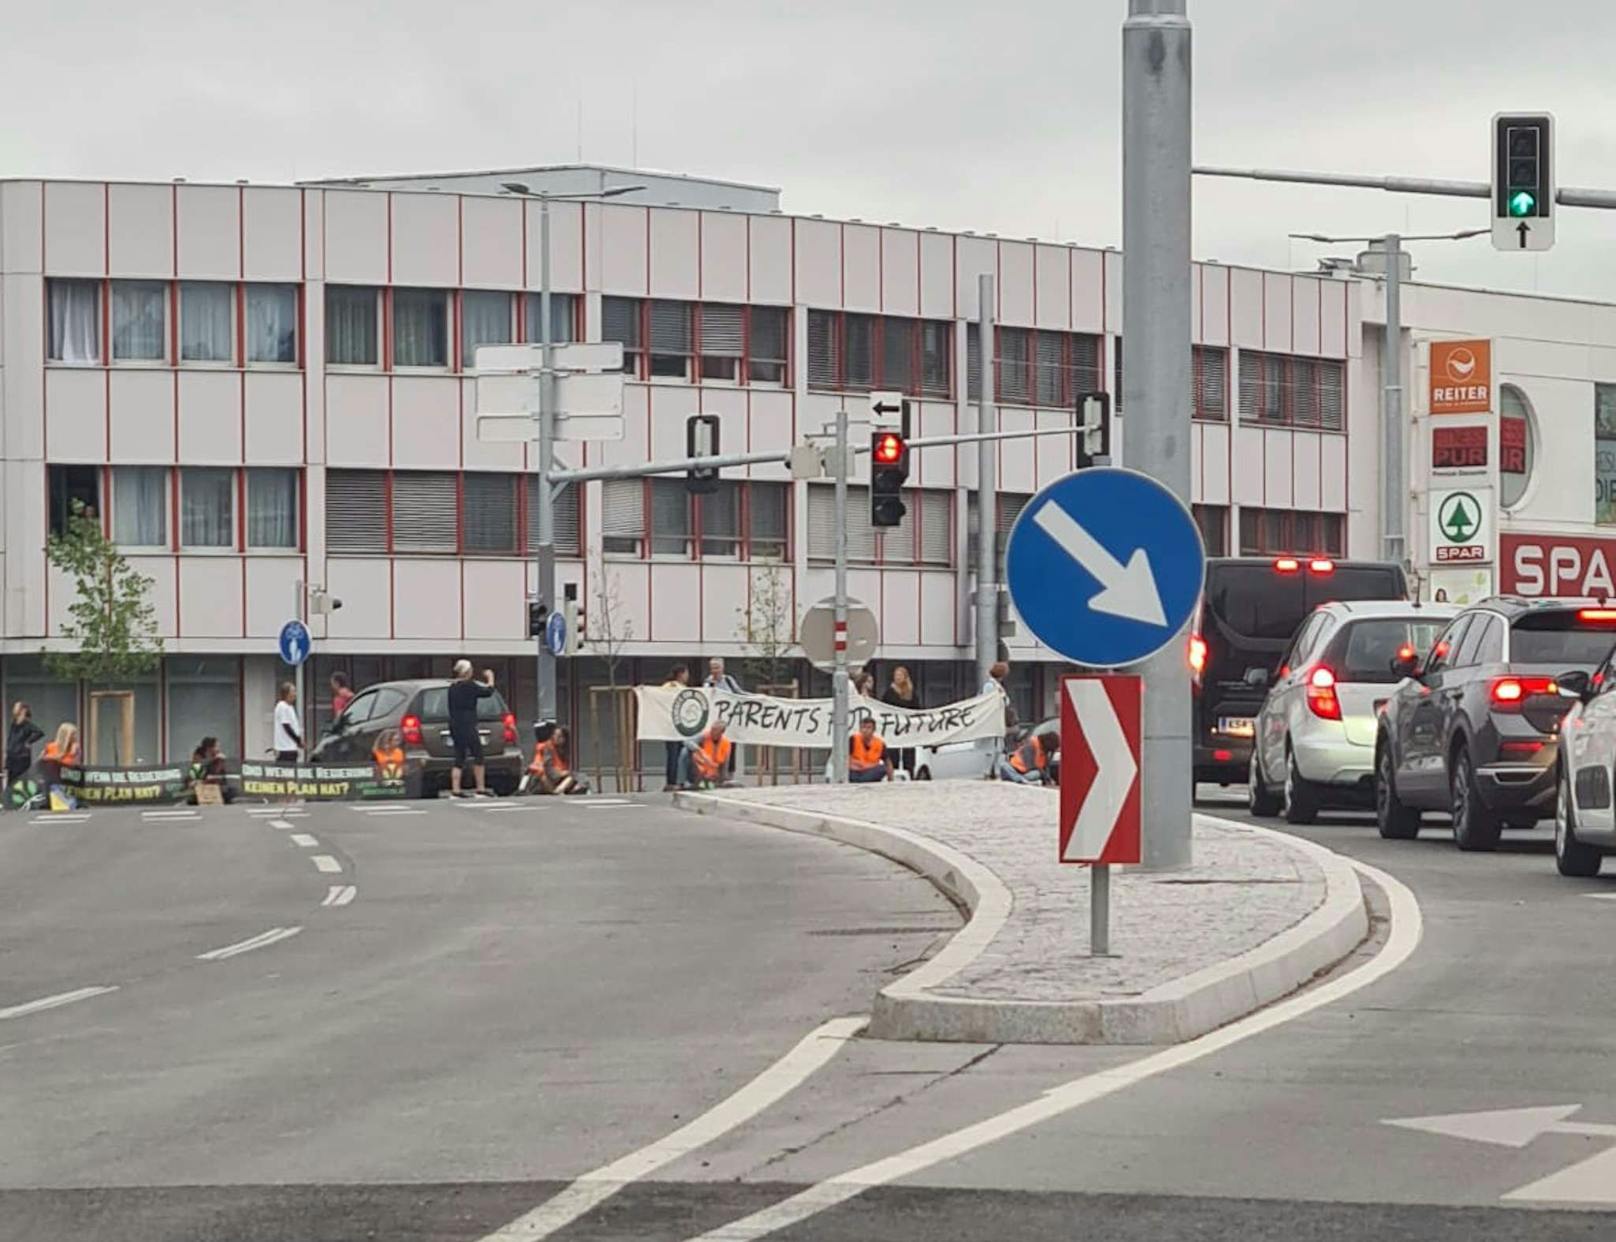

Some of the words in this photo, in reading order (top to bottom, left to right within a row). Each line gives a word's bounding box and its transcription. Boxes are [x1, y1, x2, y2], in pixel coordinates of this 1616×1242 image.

[1433, 386, 1488, 401] REITER
[1437, 547, 1483, 560] SPAR
[715, 700, 821, 734] PARENTS
[880, 704, 978, 736] FUTURE
[287, 781, 318, 795] PLAN
[320, 782, 349, 795] HAT?
